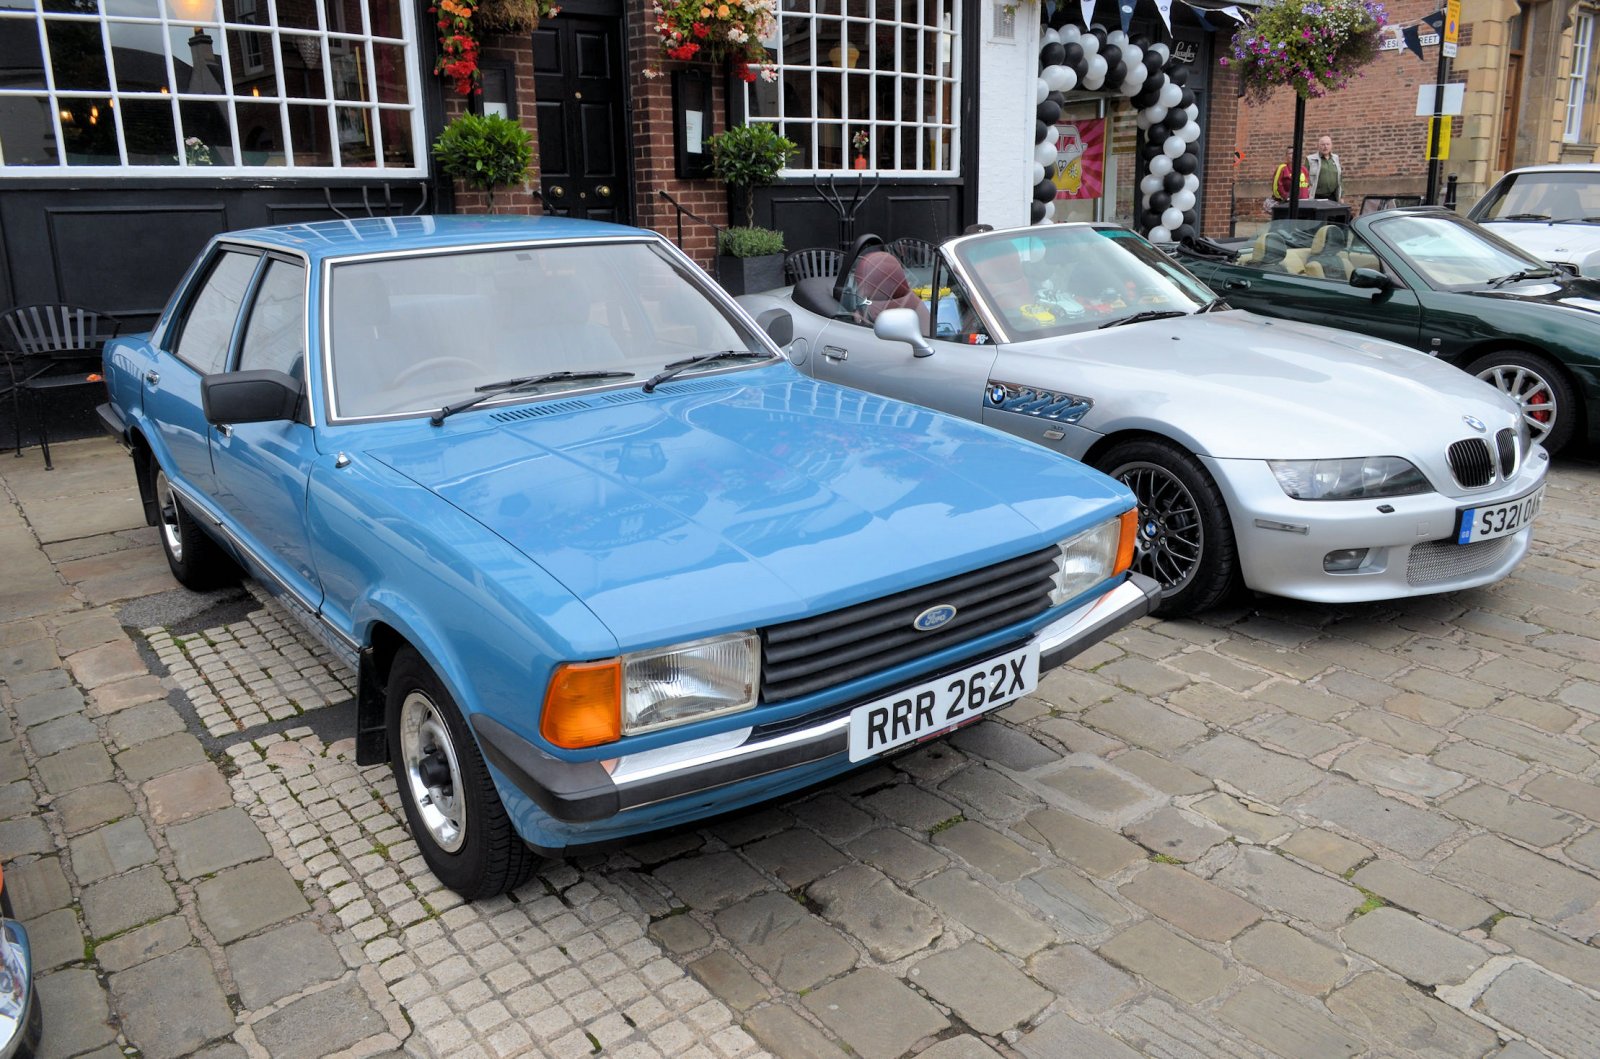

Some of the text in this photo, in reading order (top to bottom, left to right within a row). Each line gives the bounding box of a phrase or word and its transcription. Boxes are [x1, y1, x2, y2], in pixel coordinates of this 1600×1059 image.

[1480, 505, 1523, 535] S321
[924, 609, 949, 626] Ford
[867, 690, 935, 750] RRR
[945, 654, 1027, 720] 262X
